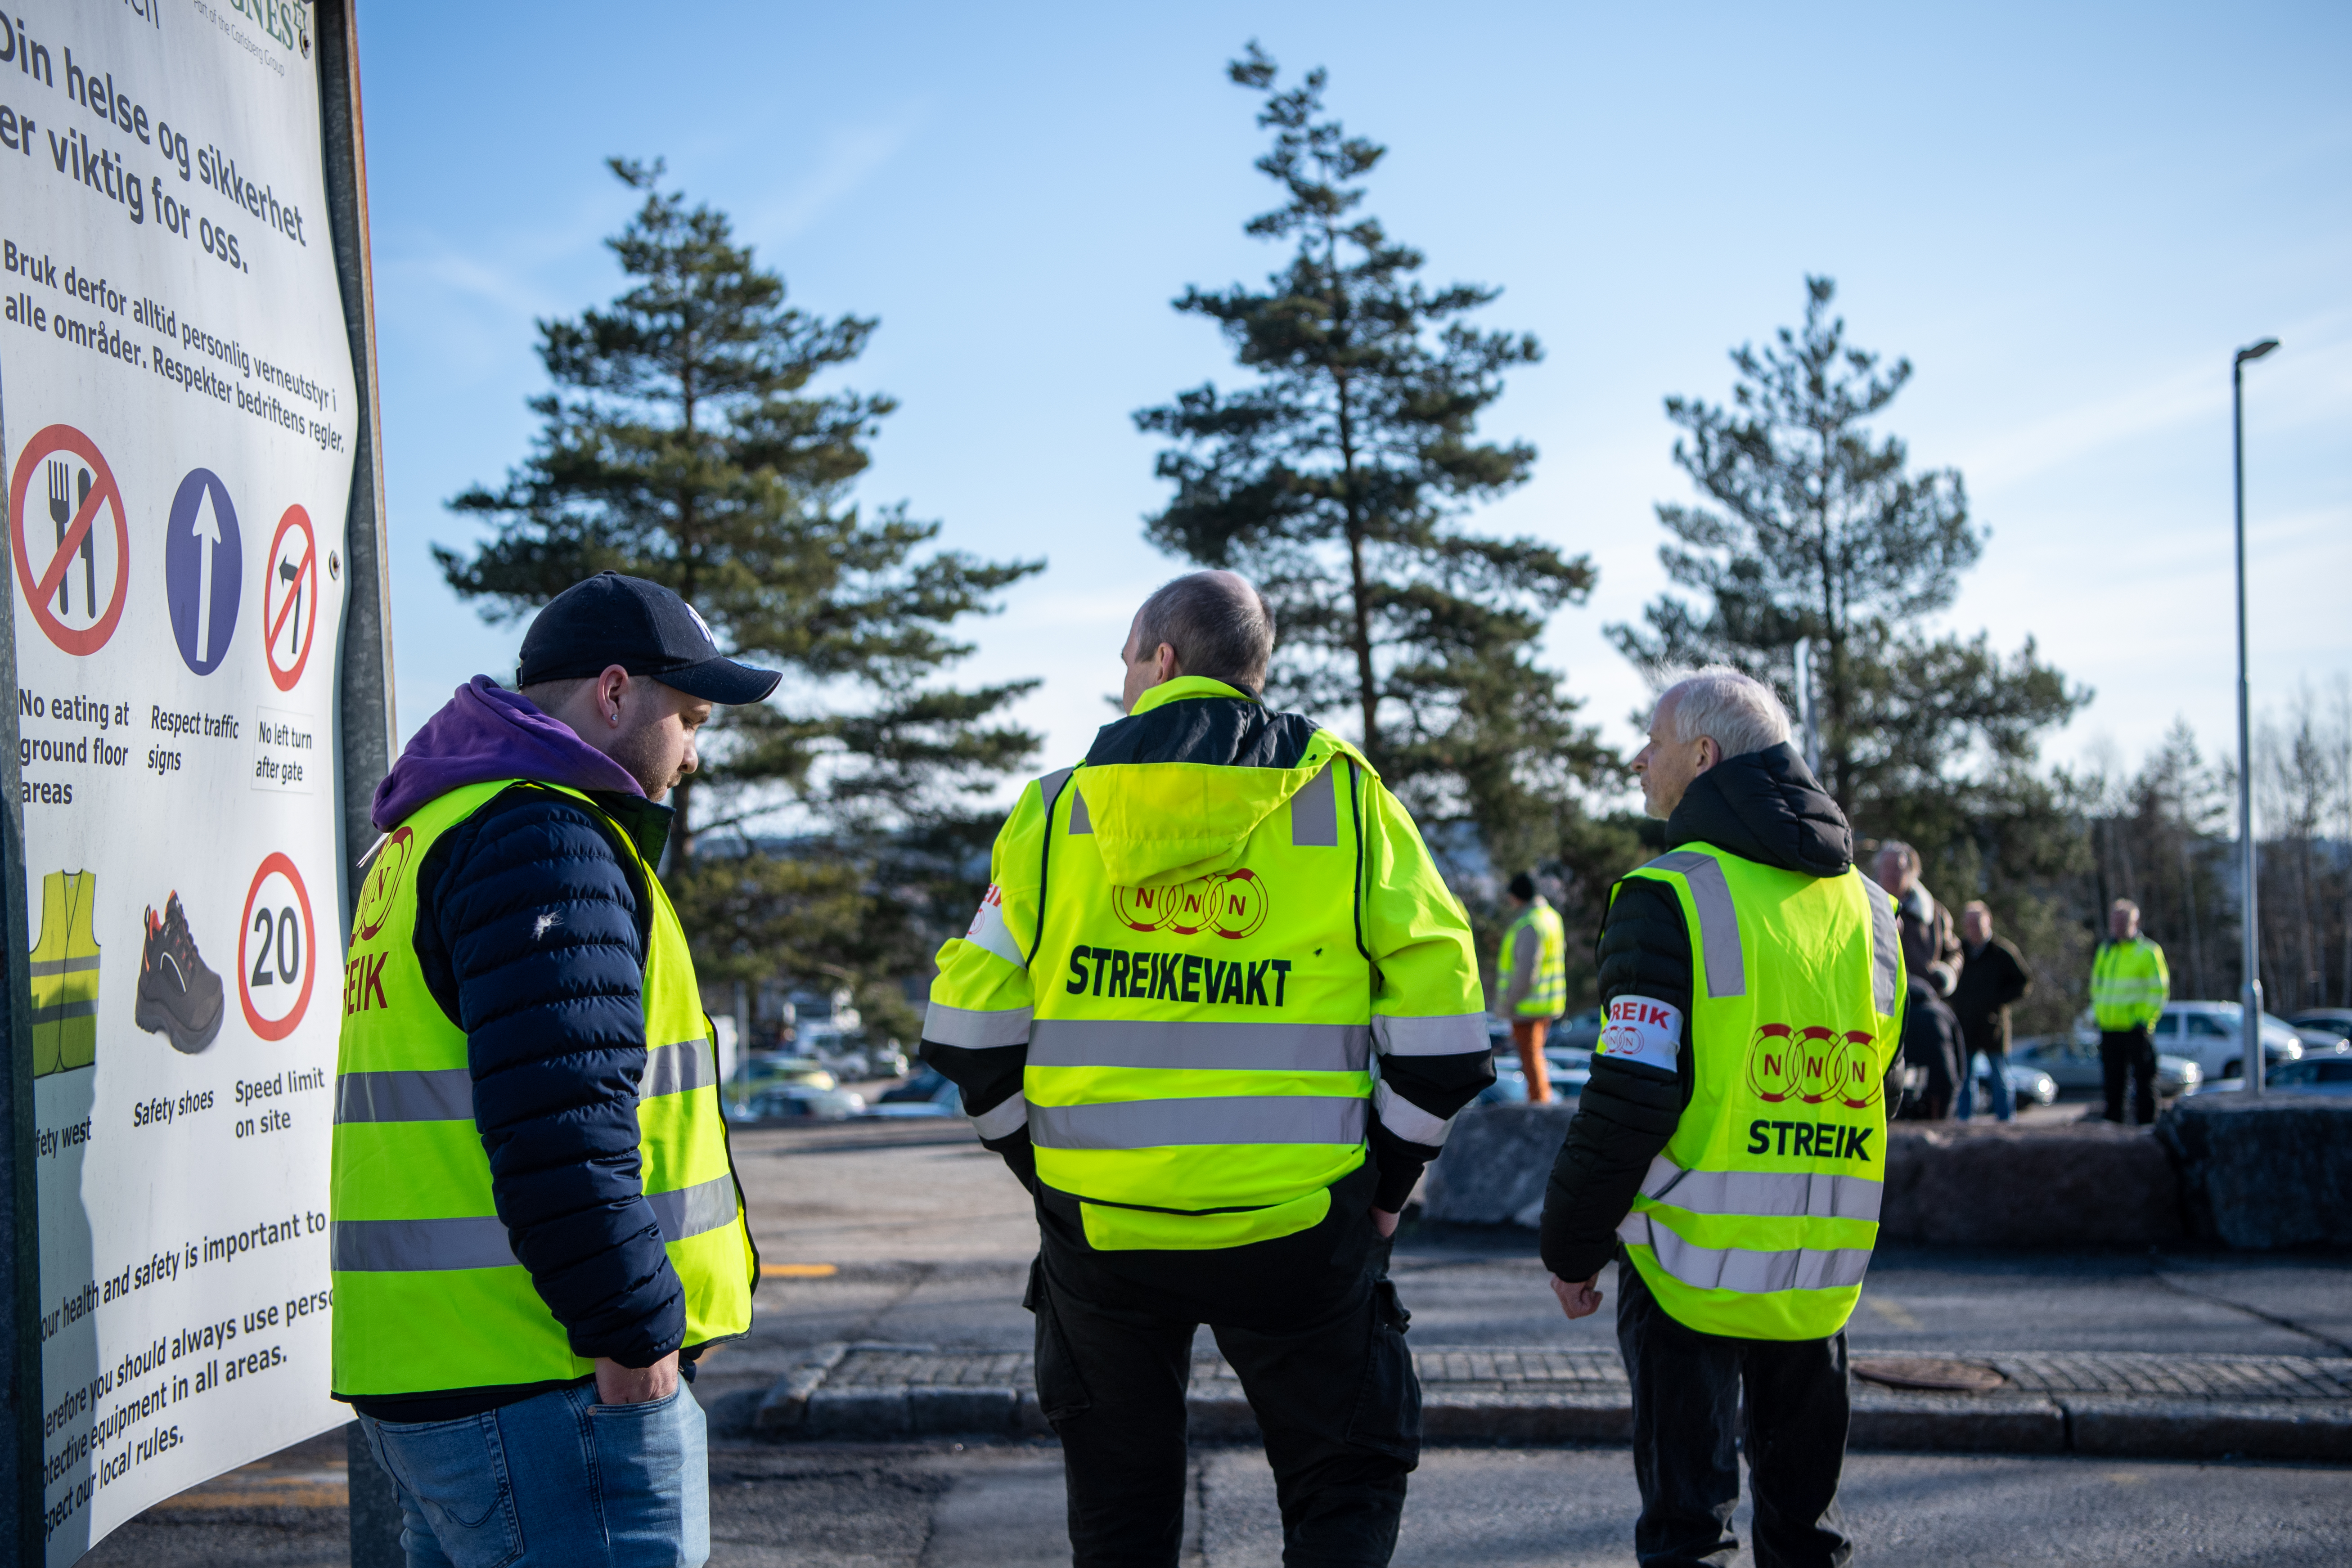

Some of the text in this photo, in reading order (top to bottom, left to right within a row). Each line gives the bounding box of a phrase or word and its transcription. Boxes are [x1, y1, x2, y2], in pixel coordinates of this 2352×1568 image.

[209, 9, 216, 24] of
[218, 14, 230, 36] the
[231, 23, 264, 65] Carlsberg
[264, 49, 285, 78] Group
[64, 46, 150, 144] helse
[159, 122, 190, 181] og
[198, 144, 306, 247] sikkerhet
[0, 105, 248, 274] er viktig for oss.
[4, 239, 336, 412] Bruk derfor alltid personlig verneutstyr i
[6, 292, 343, 453] alle områder. Respekter bedriftens regler.
[19, 688, 129, 730] No eating at
[151, 705, 239, 739] Respect traffic
[21, 736, 128, 767] ground floor
[259, 721, 311, 749] No left turn
[148, 744, 181, 775] signs
[256, 755, 302, 785] after gate
[22, 780, 73, 805] areas
[252, 907, 298, 987] 20
[1066, 944, 1292, 1007] STREIKEVAKT
[236, 1067, 324, 1106] Speed limit
[134, 1090, 213, 1127] Safety shoes
[236, 1110, 291, 1138] on site
[62, 1116, 91, 1148] west
[1747, 1119, 1874, 1162] STREIK
[63, 1280, 99, 1328] health
[104, 1265, 130, 1303] and
[135, 1251, 180, 1289] safety
[186, 1242, 198, 1269] is
[204, 1214, 301, 1262] important
[306, 1211, 325, 1233] to
[90, 1370, 113, 1412] you
[117, 1336, 166, 1387] should
[172, 1319, 236, 1360] always
[244, 1306, 278, 1334] use
[91, 1382, 168, 1451] equipment
[173, 1375, 188, 1403] in
[196, 1360, 218, 1393] all
[226, 1346, 287, 1382] areas.
[76, 1471, 97, 1509] our
[99, 1440, 132, 1490] local
[136, 1425, 183, 1465] rules.
